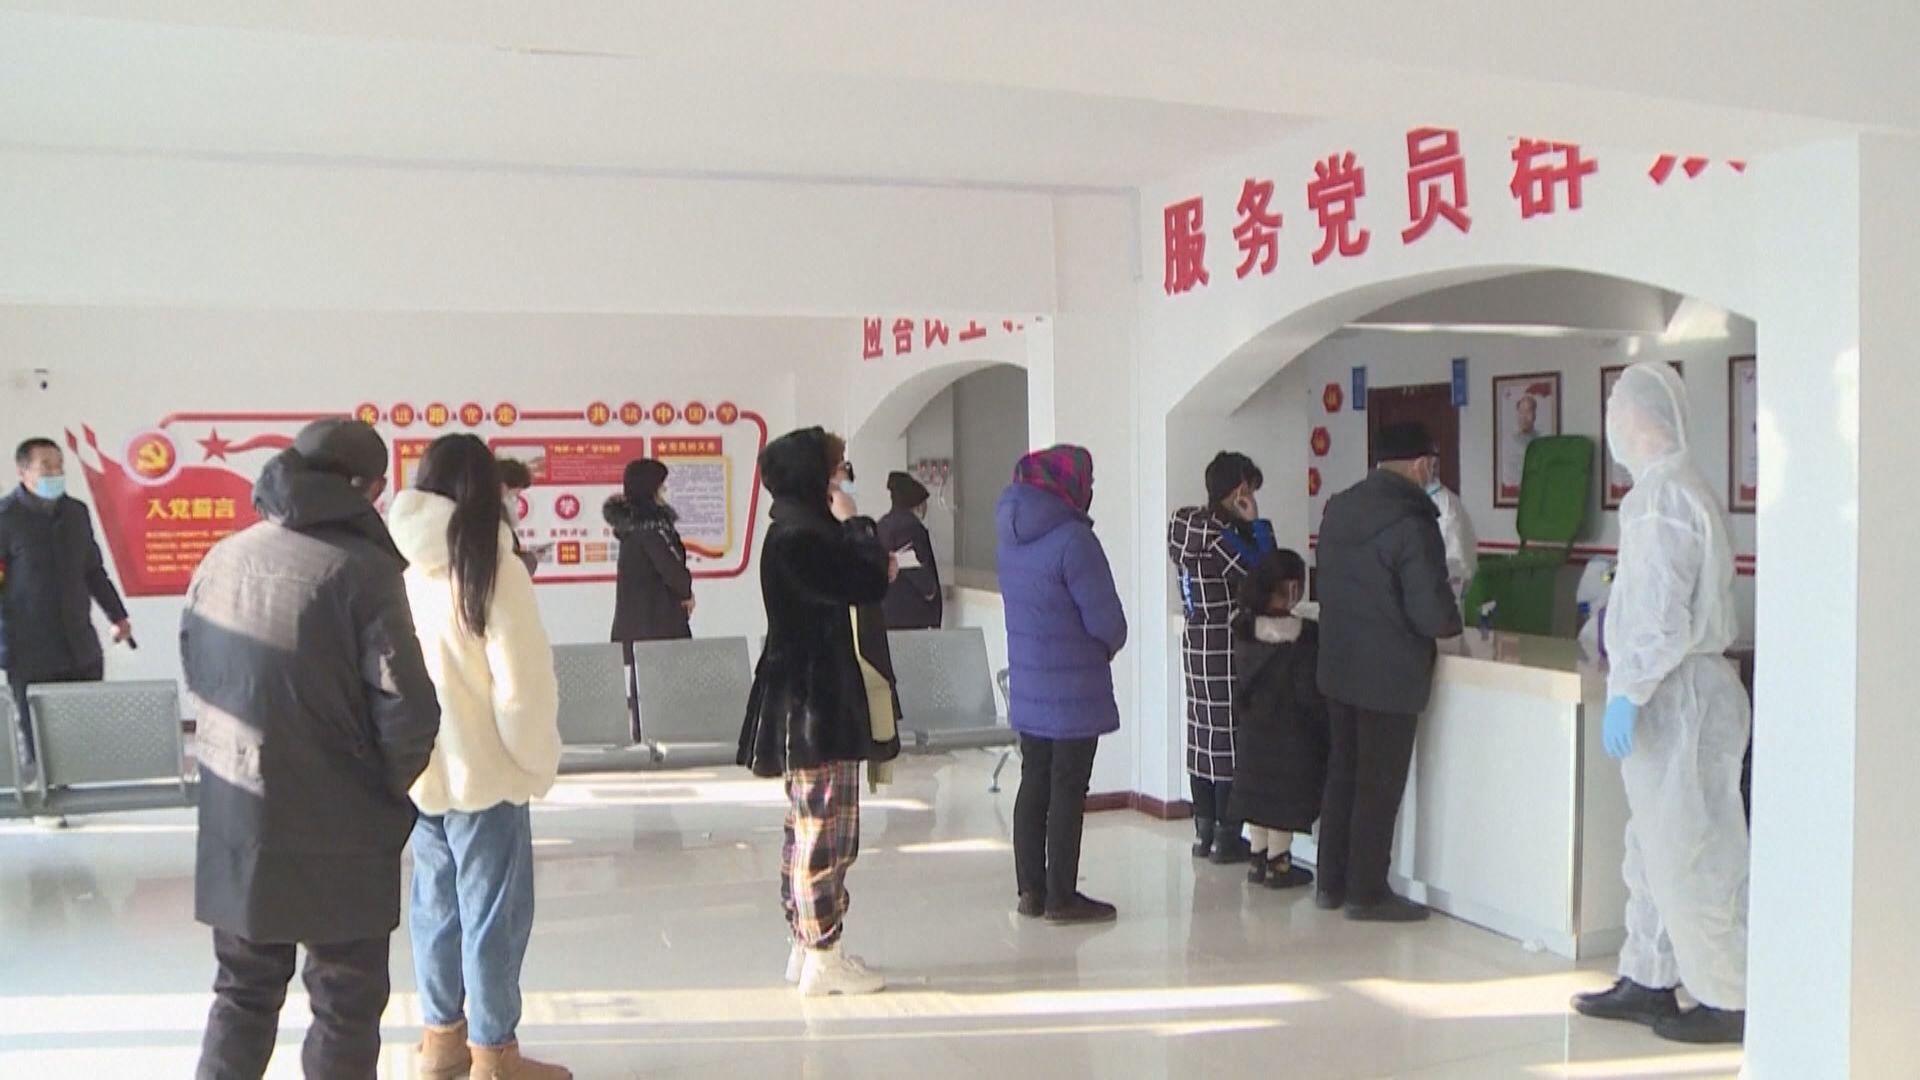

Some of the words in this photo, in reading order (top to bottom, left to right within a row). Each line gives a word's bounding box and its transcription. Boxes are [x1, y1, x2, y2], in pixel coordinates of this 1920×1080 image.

[1164, 127, 1746, 295] 服务党员群
[145, 497, 236, 520] 入党誓言
